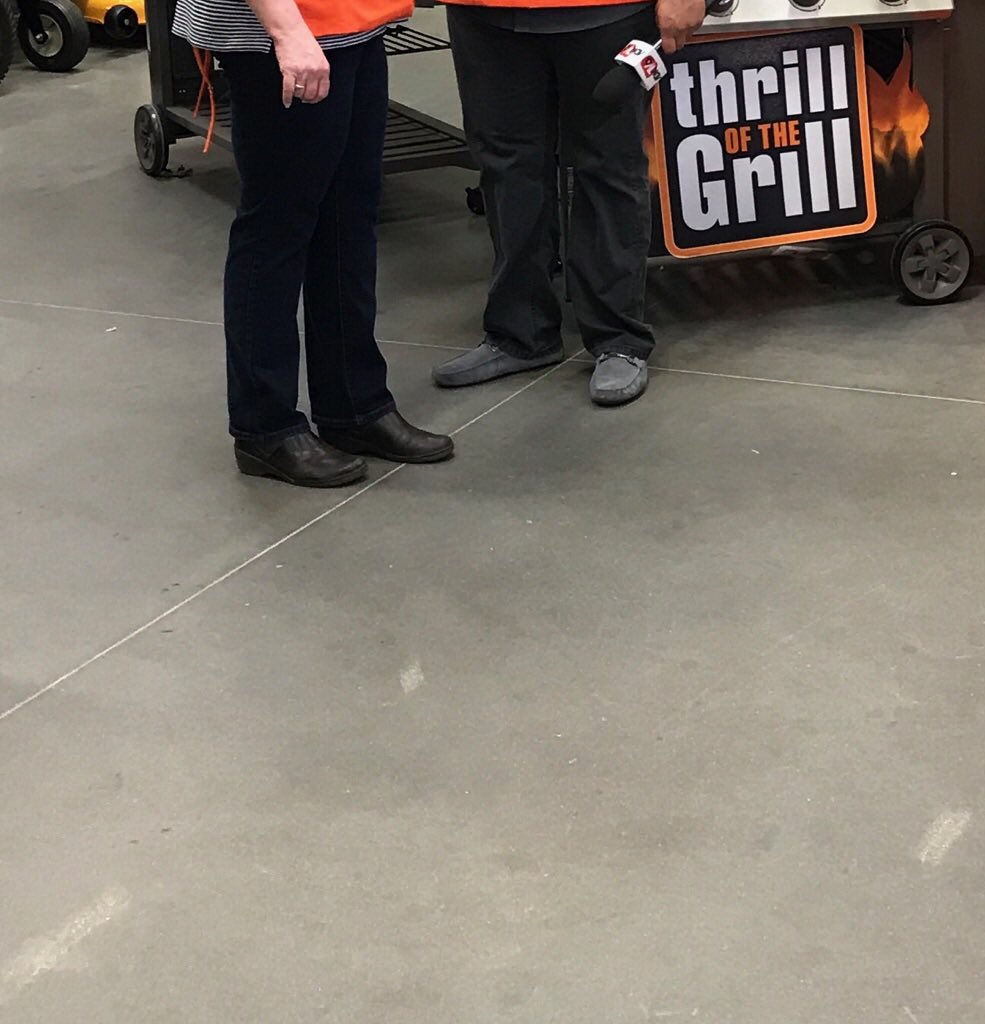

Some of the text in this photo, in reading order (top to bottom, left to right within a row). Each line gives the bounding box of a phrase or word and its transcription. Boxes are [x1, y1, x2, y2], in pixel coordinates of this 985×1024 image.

[670, 44, 849, 128] thrill
[675, 117, 858, 232] Grill
[724, 119, 801, 155] OF THE
